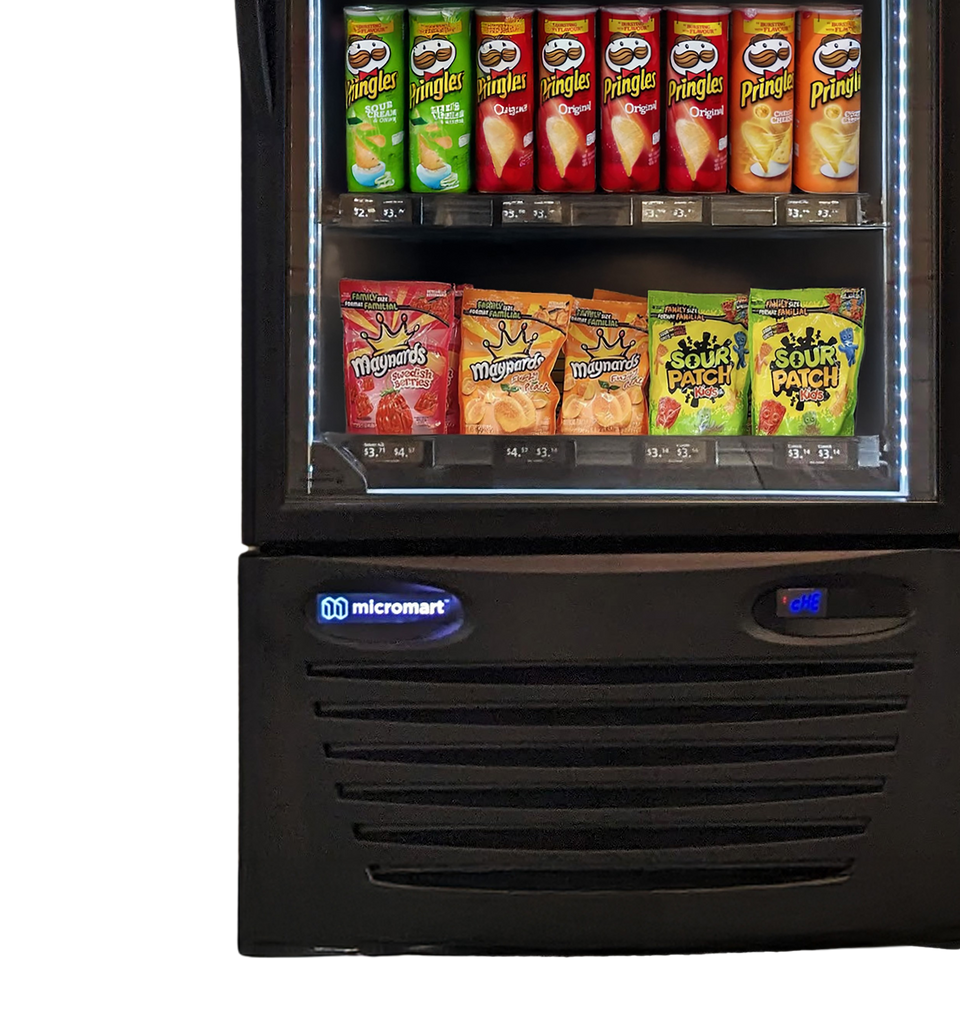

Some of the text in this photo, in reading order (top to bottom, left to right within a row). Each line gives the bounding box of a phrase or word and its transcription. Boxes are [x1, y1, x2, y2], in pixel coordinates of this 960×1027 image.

[604, 68, 656, 103] Pringles
[667, 69, 724, 106] Pringles
[740, 69, 794, 108] Pringle
[810, 69, 861, 109] Pringl
[558, 101, 592, 116] Original
[624, 100, 657, 115] Original
[689, 105, 724, 120] Original
[352, 293, 377, 301] FAMILY
[364, 302, 398, 310] FAMILIAL
[777, 308, 808, 316] FAMILIAL
[489, 310, 521, 319] FAMILIAL
[676, 313, 705, 321] FAMILIAL
[588, 318, 619, 327] FAMILIAL
[671, 344, 731, 369] SOUR
[775, 345, 836, 369] SOUR
[394, 378, 430, 389] Berries
[667, 365, 733, 392] PATCH
[771, 366, 840, 392] PATCH
[693, 385, 719, 399] Kids
[800, 387, 825, 401] Kids
[352, 599, 444, 616] micromart
